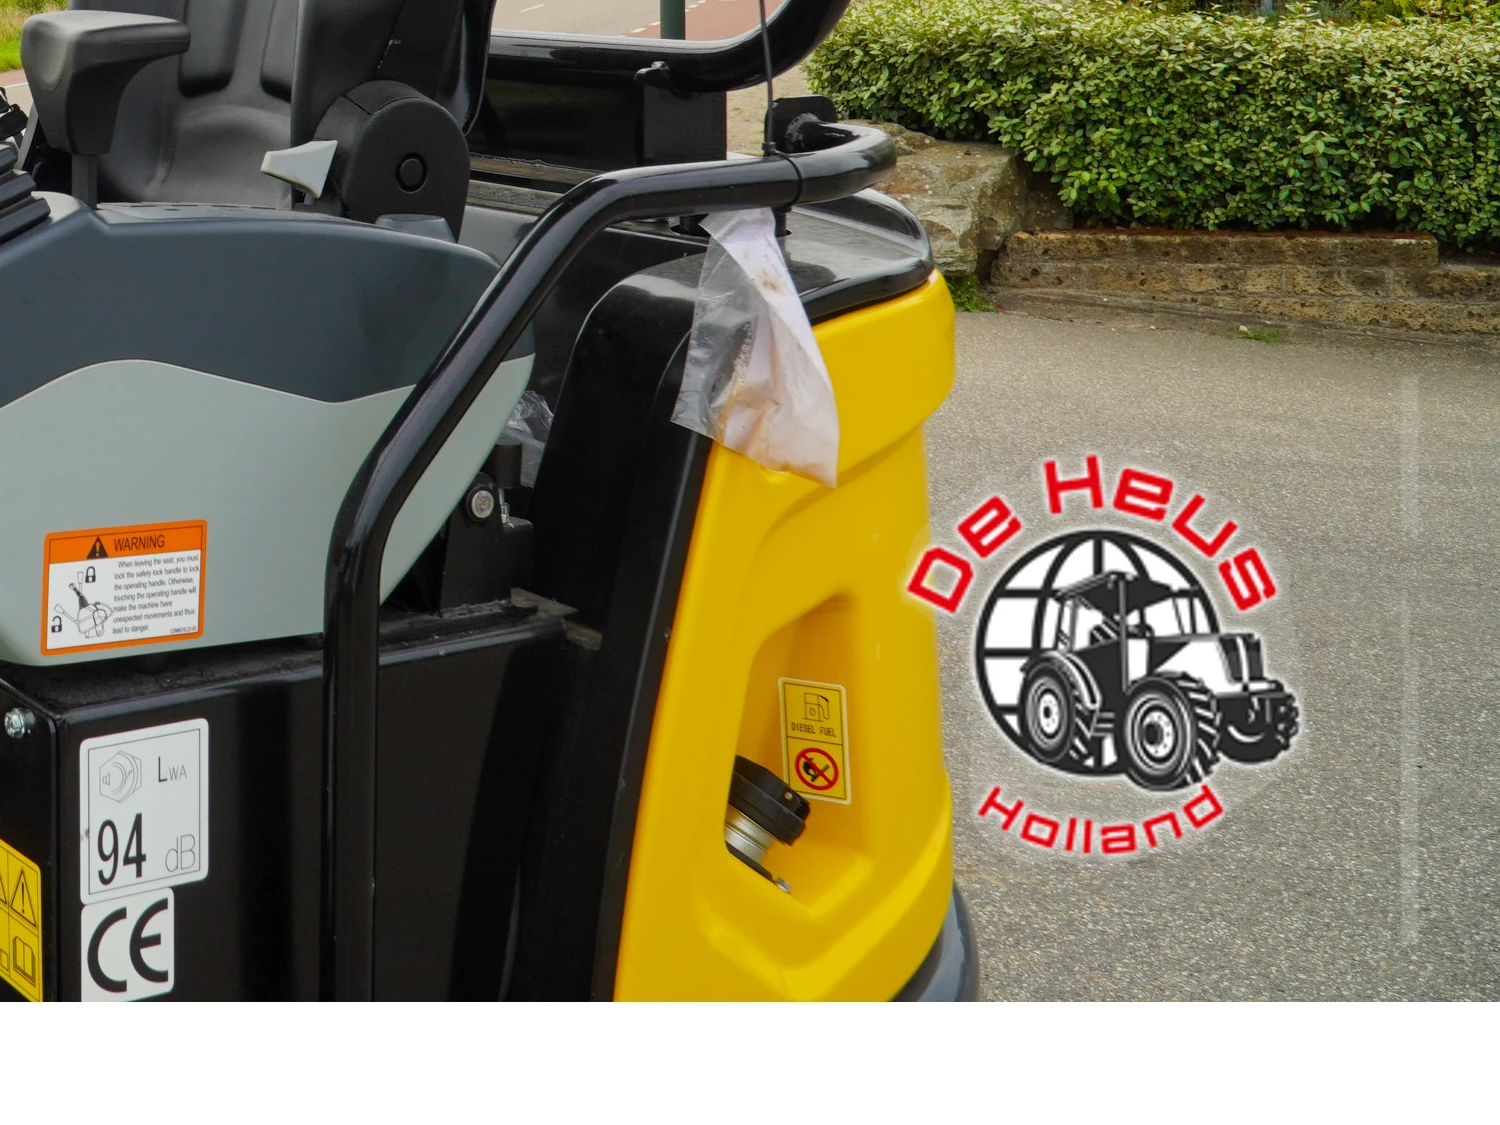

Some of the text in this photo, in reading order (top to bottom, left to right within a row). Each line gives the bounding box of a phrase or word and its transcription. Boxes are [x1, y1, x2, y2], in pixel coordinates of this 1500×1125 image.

[114, 534, 165, 551] WARNING
[123, 582, 147, 590] operating
[146, 590, 169, 598] operating
[113, 613, 142, 623] unexpected
[144, 611, 172, 619] movements
[791, 722, 836, 737] DIESEL FUEL
[97, 811, 196, 886] 94 dB
[86, 896, 169, 994] CE
